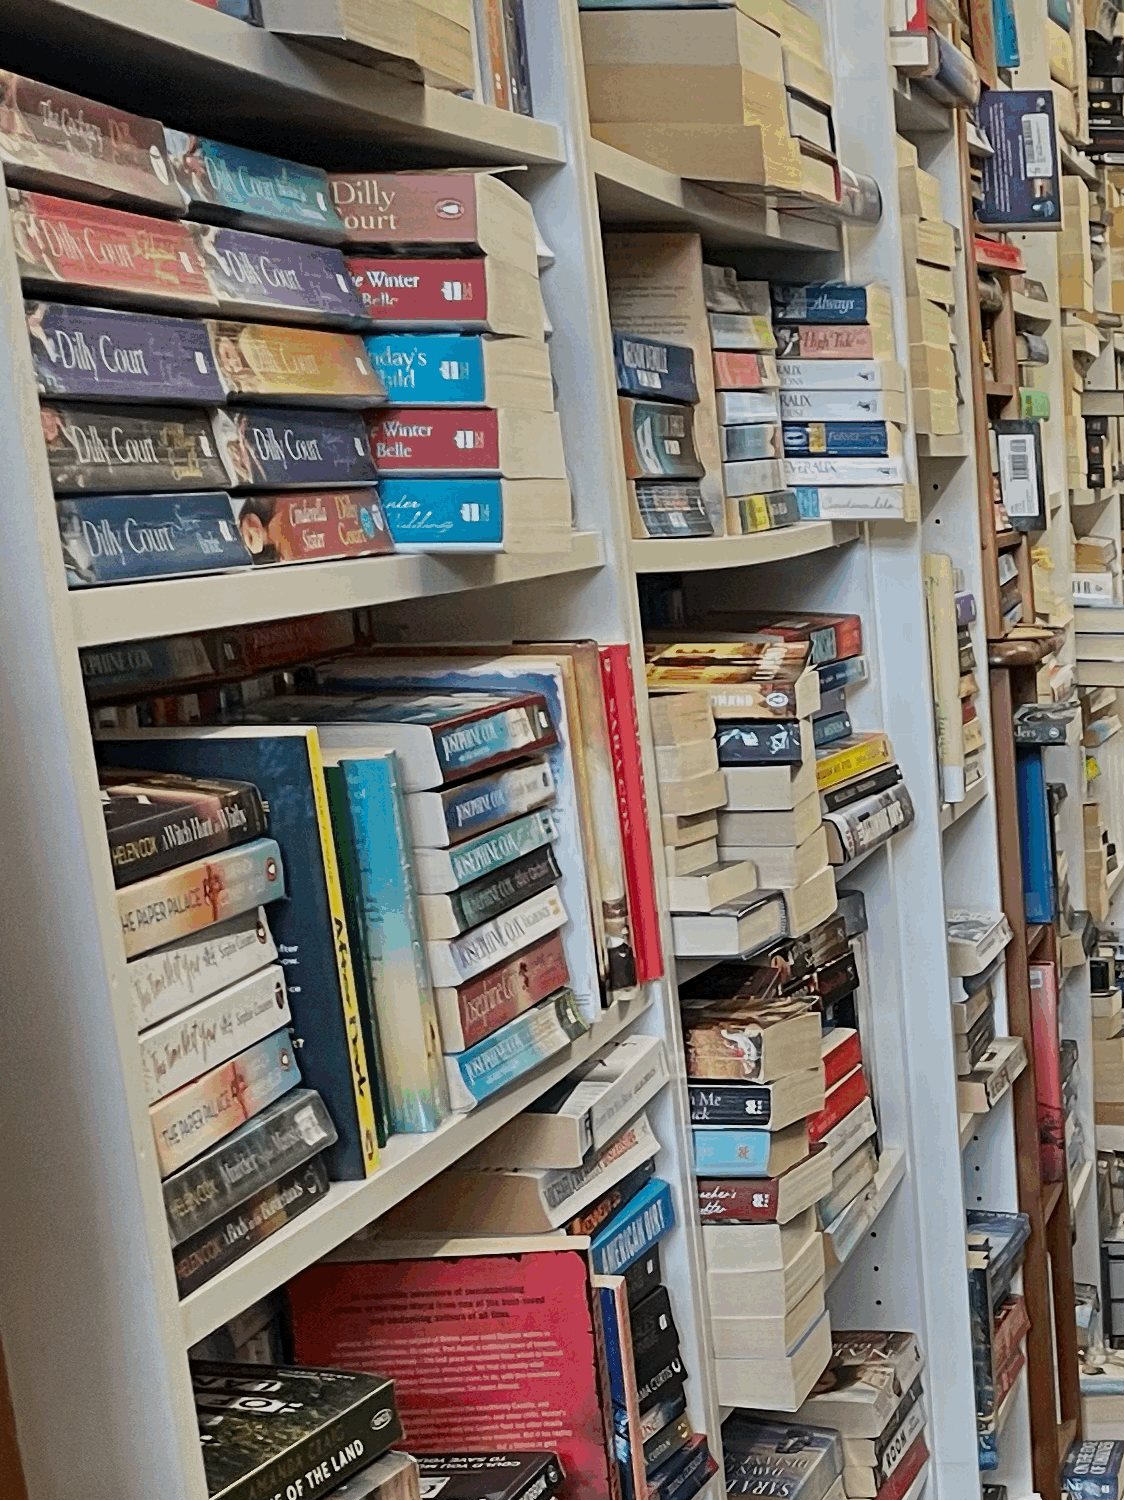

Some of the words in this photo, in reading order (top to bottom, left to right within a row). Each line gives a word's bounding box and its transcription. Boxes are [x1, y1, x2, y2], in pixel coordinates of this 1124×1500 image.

[333, 180, 395, 211] Dilly
[366, 271, 420, 288] Winter
[56, 330, 98, 381] Dilly
[99, 335, 149, 375] Court
[70, 425, 114, 474] Dilly
[111, 426, 159, 463] Court
[253, 427, 287, 469] Dilly
[384, 421, 432, 437] Winter
[82, 518, 126, 566] Dilly
[124, 517, 173, 554] Court
[600, 1213, 648, 1276] AMERICAN
[644, 1200, 666, 1241] DIRT
[304, 1462, 334, 1491] THE
[332, 1438, 364, 1475] LAND
[886, 1429, 907, 1468] ROOM
